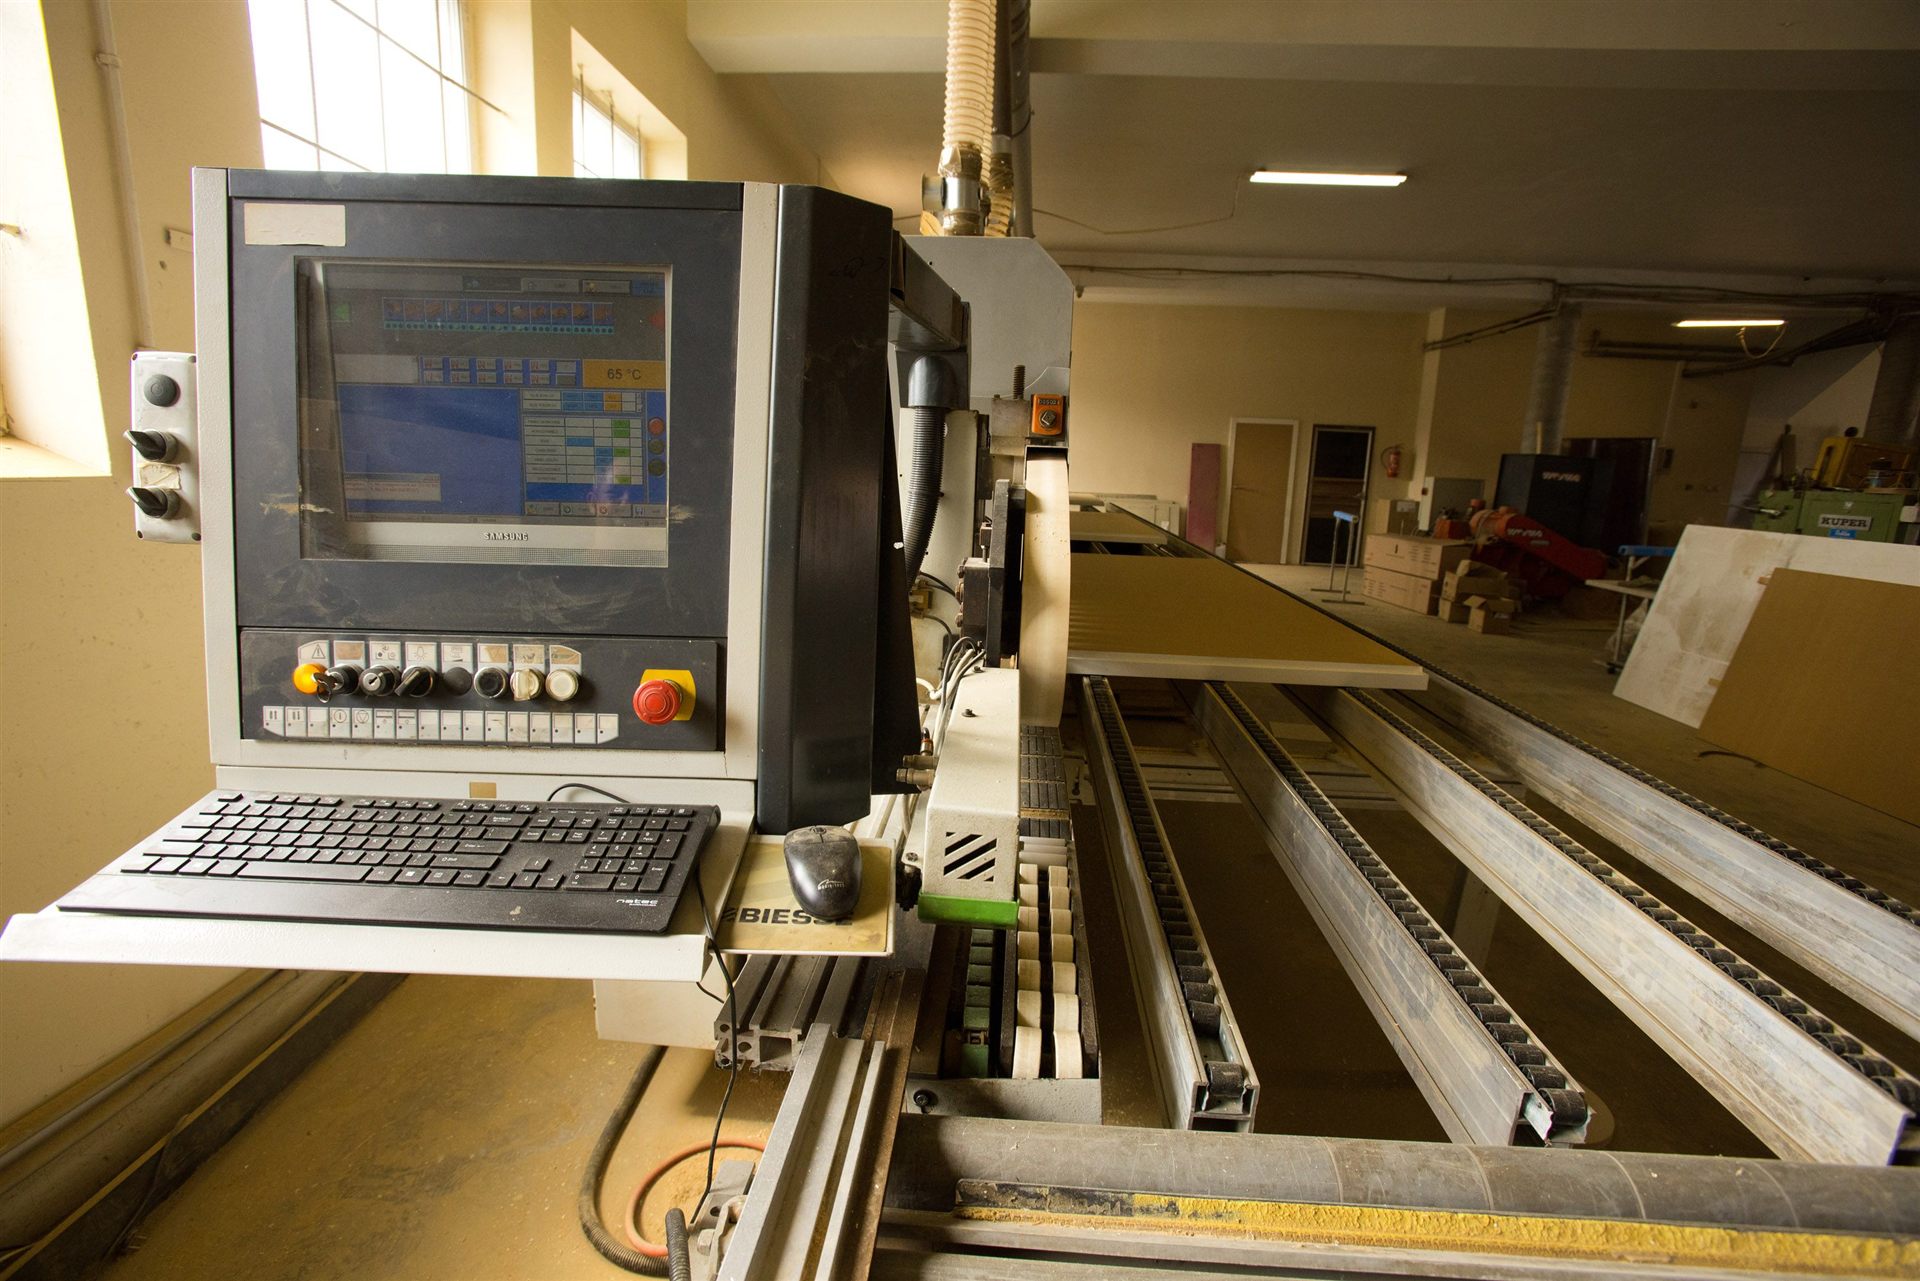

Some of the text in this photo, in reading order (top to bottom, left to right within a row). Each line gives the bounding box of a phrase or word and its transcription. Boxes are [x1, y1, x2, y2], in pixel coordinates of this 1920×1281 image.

[607, 368, 641, 381] 65 °C
[1821, 517, 1867, 527] KUPER
[483, 532, 529, 541] SAMSUNG
[739, 908, 852, 925] BIES
